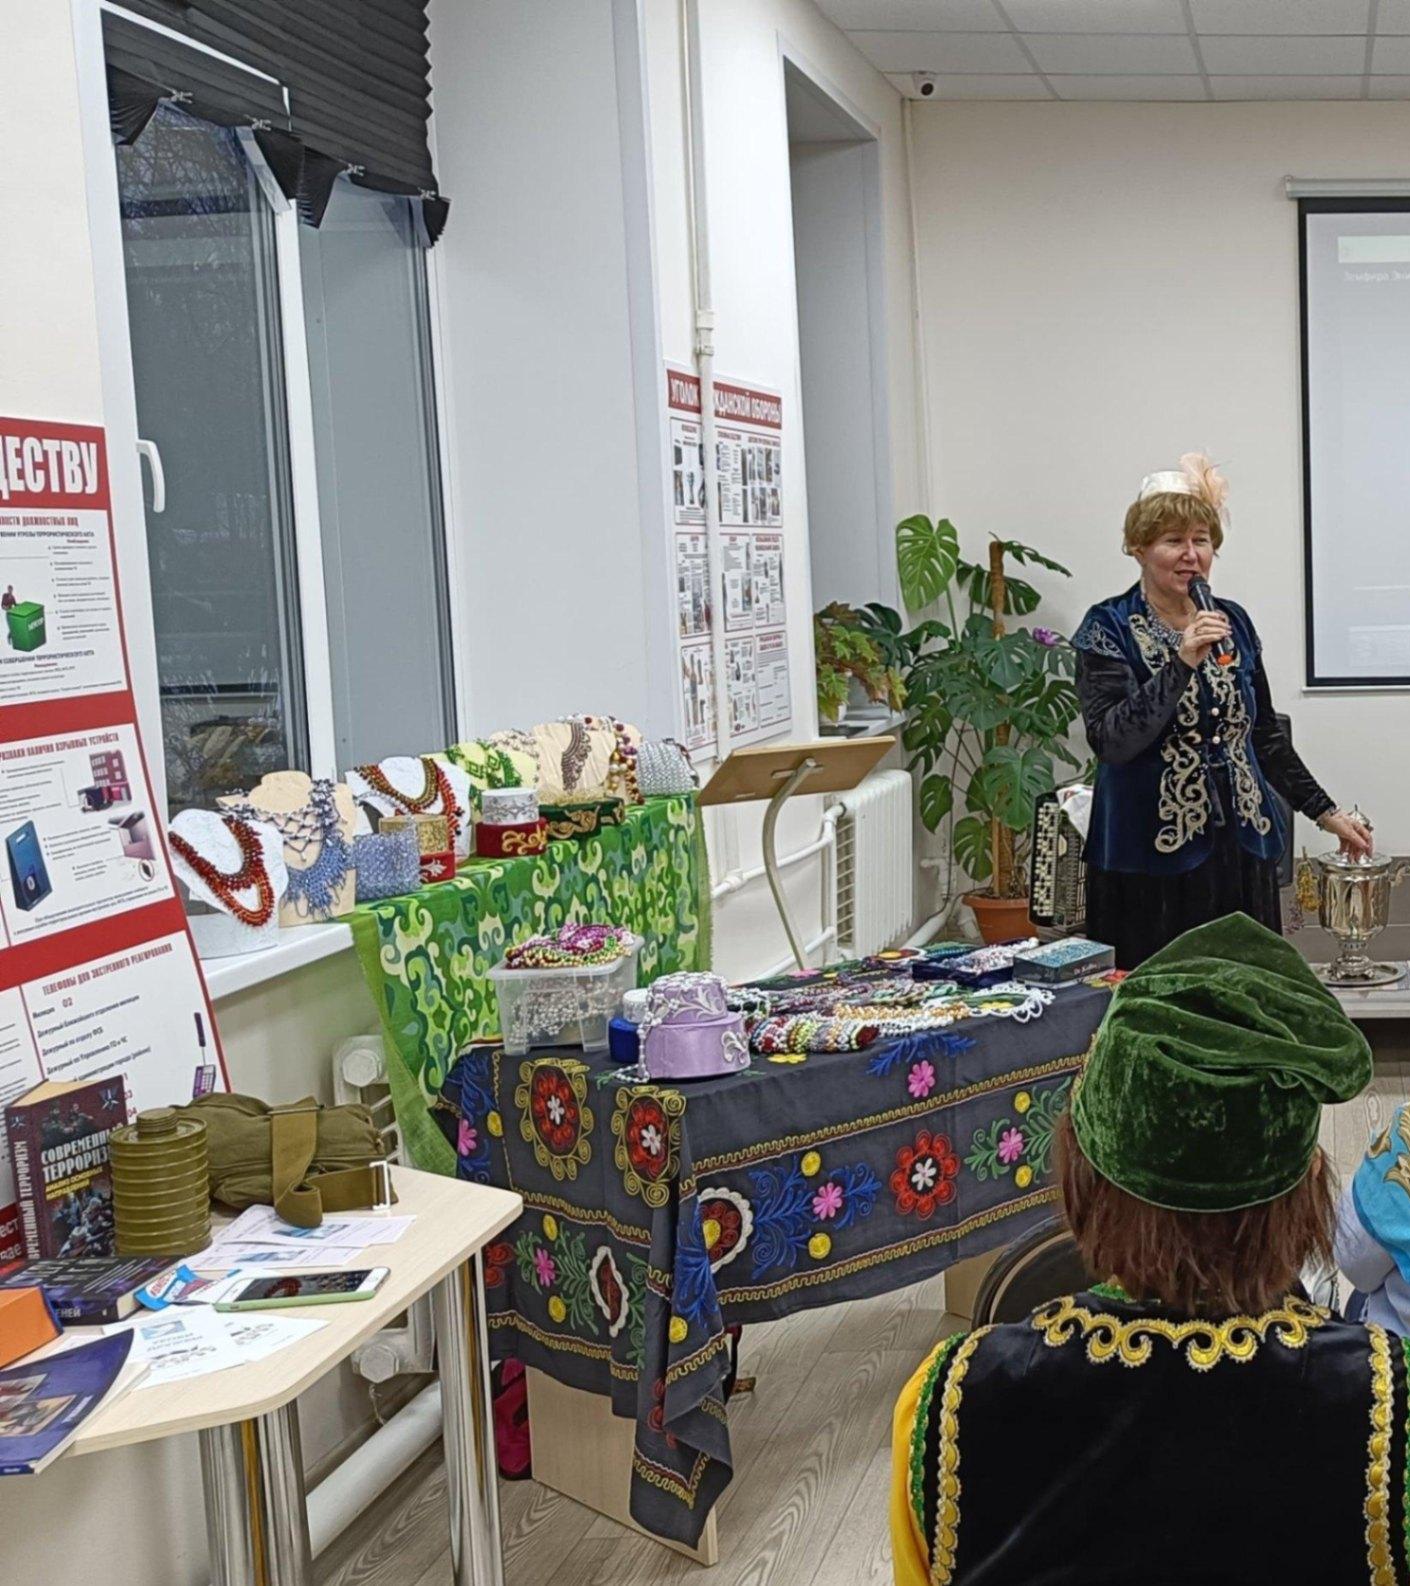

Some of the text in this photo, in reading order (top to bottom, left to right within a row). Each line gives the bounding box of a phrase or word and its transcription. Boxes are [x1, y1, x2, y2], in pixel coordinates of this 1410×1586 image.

[41, 1123, 123, 1165] СОВРЕМЕНН
[43, 1144, 109, 1184] ТЕРРОРИЗ
[20, 1199, 40, 1260] ВРЕМЕННЫЙ
